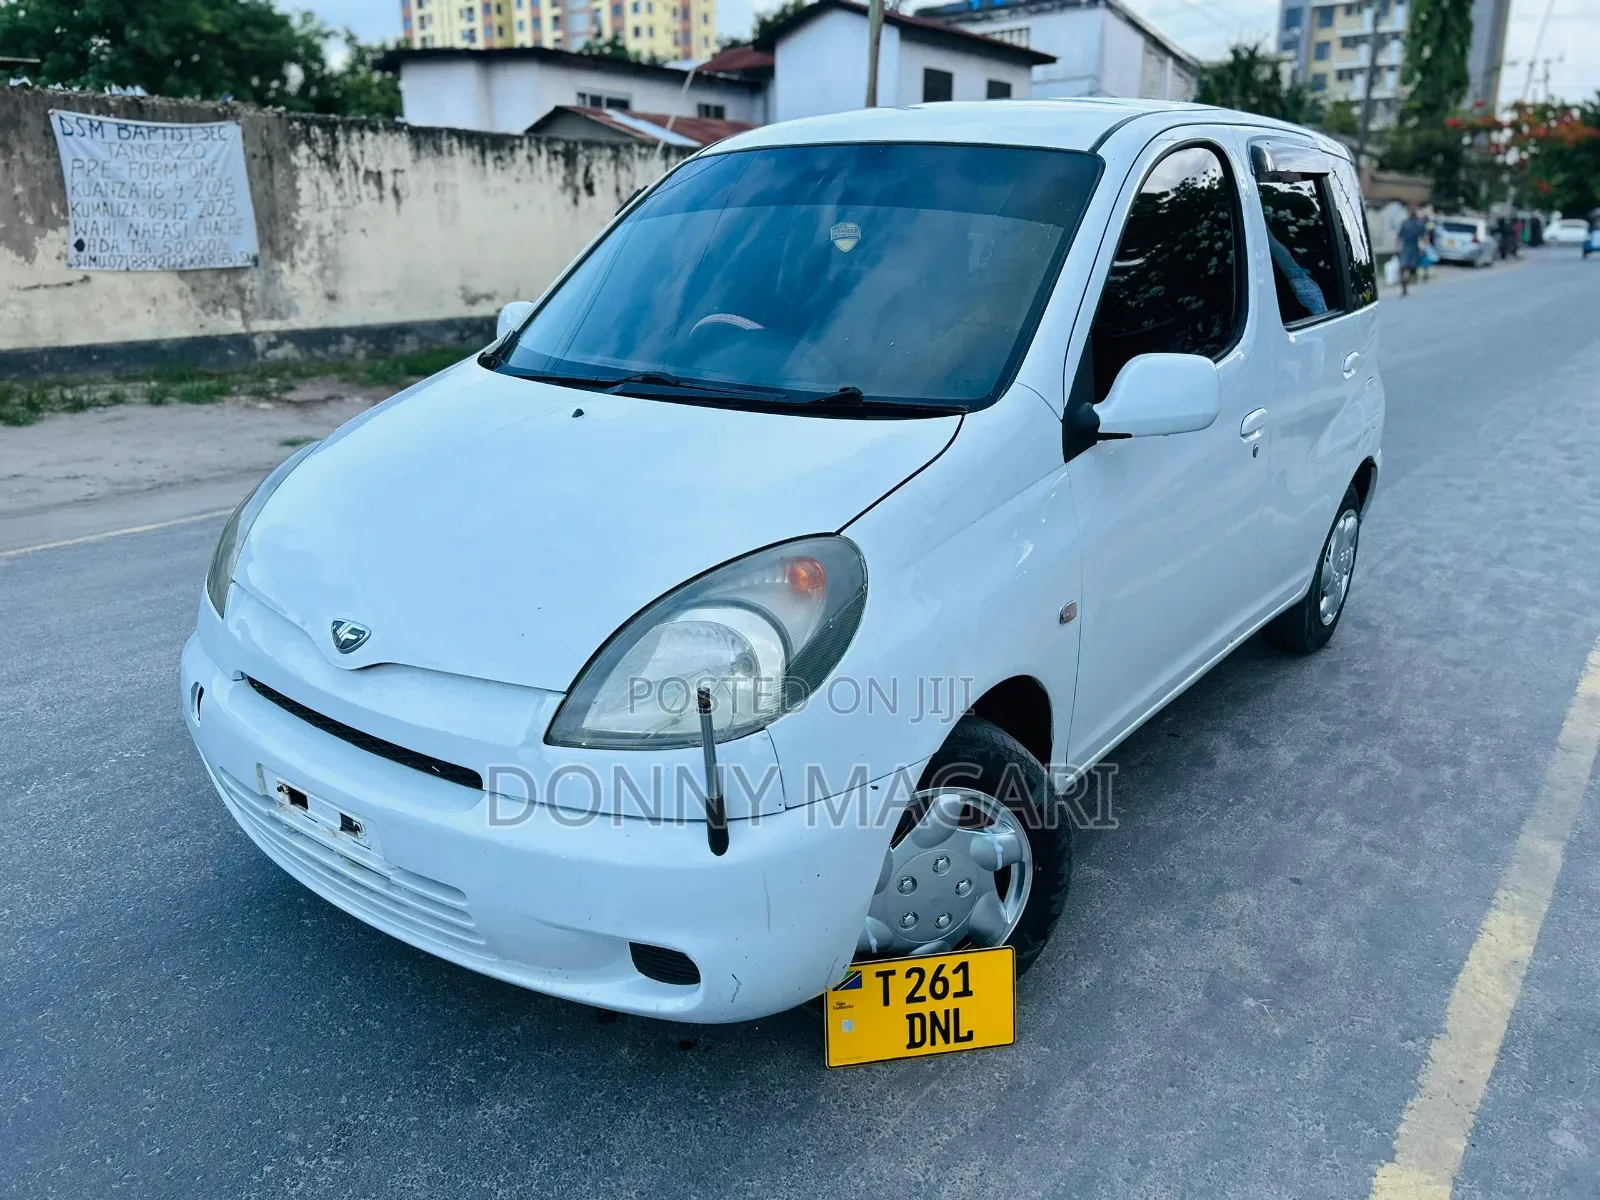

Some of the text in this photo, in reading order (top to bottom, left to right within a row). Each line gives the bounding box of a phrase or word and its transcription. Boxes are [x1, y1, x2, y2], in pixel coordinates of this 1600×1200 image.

[59, 115, 105, 139] DSM
[102, 141, 207, 161] TANGAZO
[187, 160, 220, 179] ONE
[73, 221, 116, 237] WAHI
[126, 222, 188, 240] NAFASI
[875, 960, 974, 1007] T 261
[905, 1007, 975, 1051] DNL
